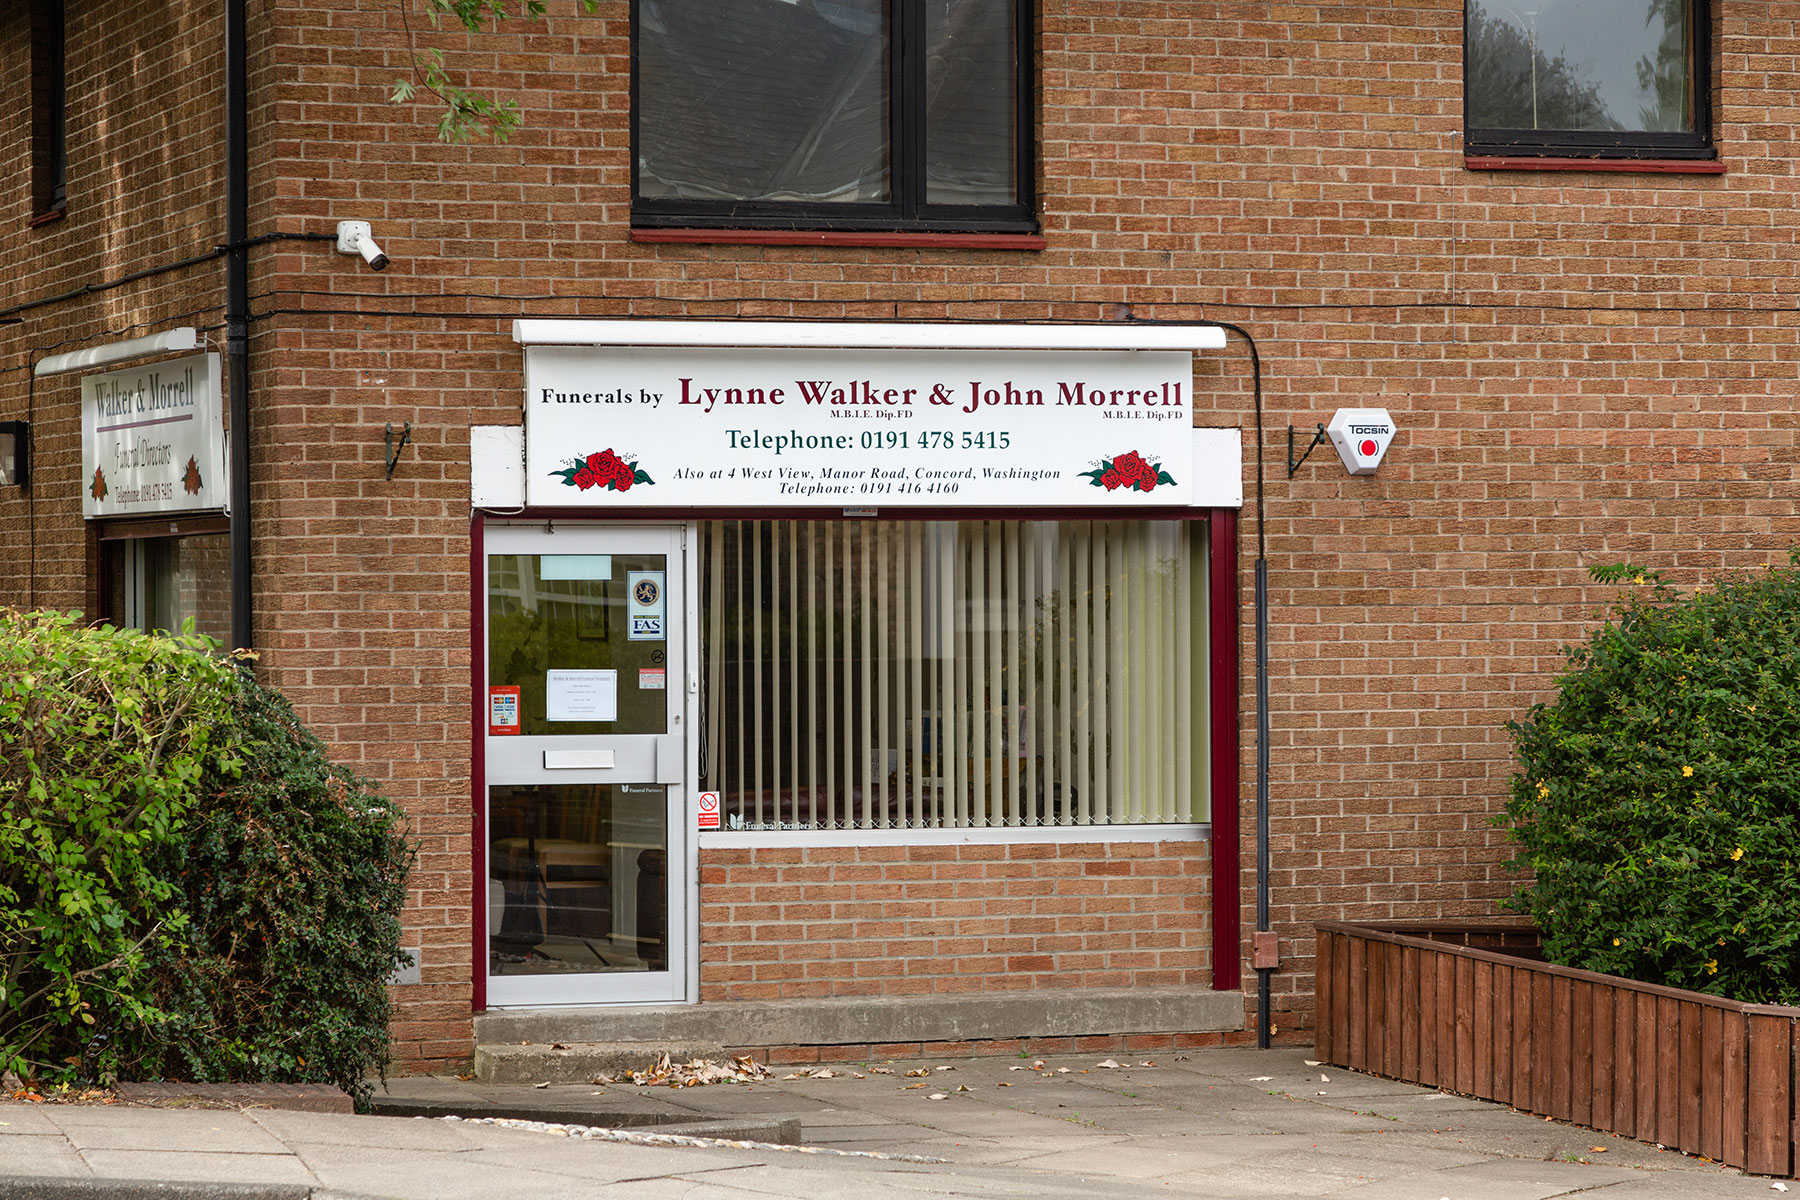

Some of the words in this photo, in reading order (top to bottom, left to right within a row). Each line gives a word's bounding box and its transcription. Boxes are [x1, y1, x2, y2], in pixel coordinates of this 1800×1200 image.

[95, 379, 133, 418] Walker
[136, 378, 145, 413] &
[149, 366, 194, 411] Morrell
[540, 388, 633, 404] Funerals
[639, 388, 664, 409] by
[677, 377, 785, 414] Lynne
[794, 379, 918, 406] Walker
[928, 382, 955, 406] &
[962, 380, 1045, 414] John
[1055, 381, 1183, 407] Morrell
[830, 409, 873, 418] M.B.I.E.
[875, 409, 913, 421] Dip.FD
[1102, 410, 1145, 419] M.B.I.E.
[1147, 410, 1183, 422] Dip.FD
[725, 429, 854, 456] Telephone:
[860, 430, 910, 450] 0191
[917, 430, 955, 450] 478
[961, 431, 1010, 450] 5415
[115, 435, 140, 475] Funeral
[141, 437, 171, 467] Directors
[673, 467, 704, 479] Also
[709, 469, 723, 479] at
[727, 467, 736, 479] 4
[741, 467, 773, 479] West
[778, 467, 815, 481] View,
[819, 467, 866, 479] Manor
[870, 467, 910, 481] Road,
[914, 467, 977, 481] Concord,
[982, 467, 1060, 482] Washington
[779, 482, 855, 497] Telephone:
[860, 482, 892, 494] 0191
[897, 482, 922, 494] 416
[926, 482, 959, 494] 4160
[633, 620, 660, 630] FAS
[745, 821, 776, 830] Funeral
[779, 821, 812, 830] Partners
